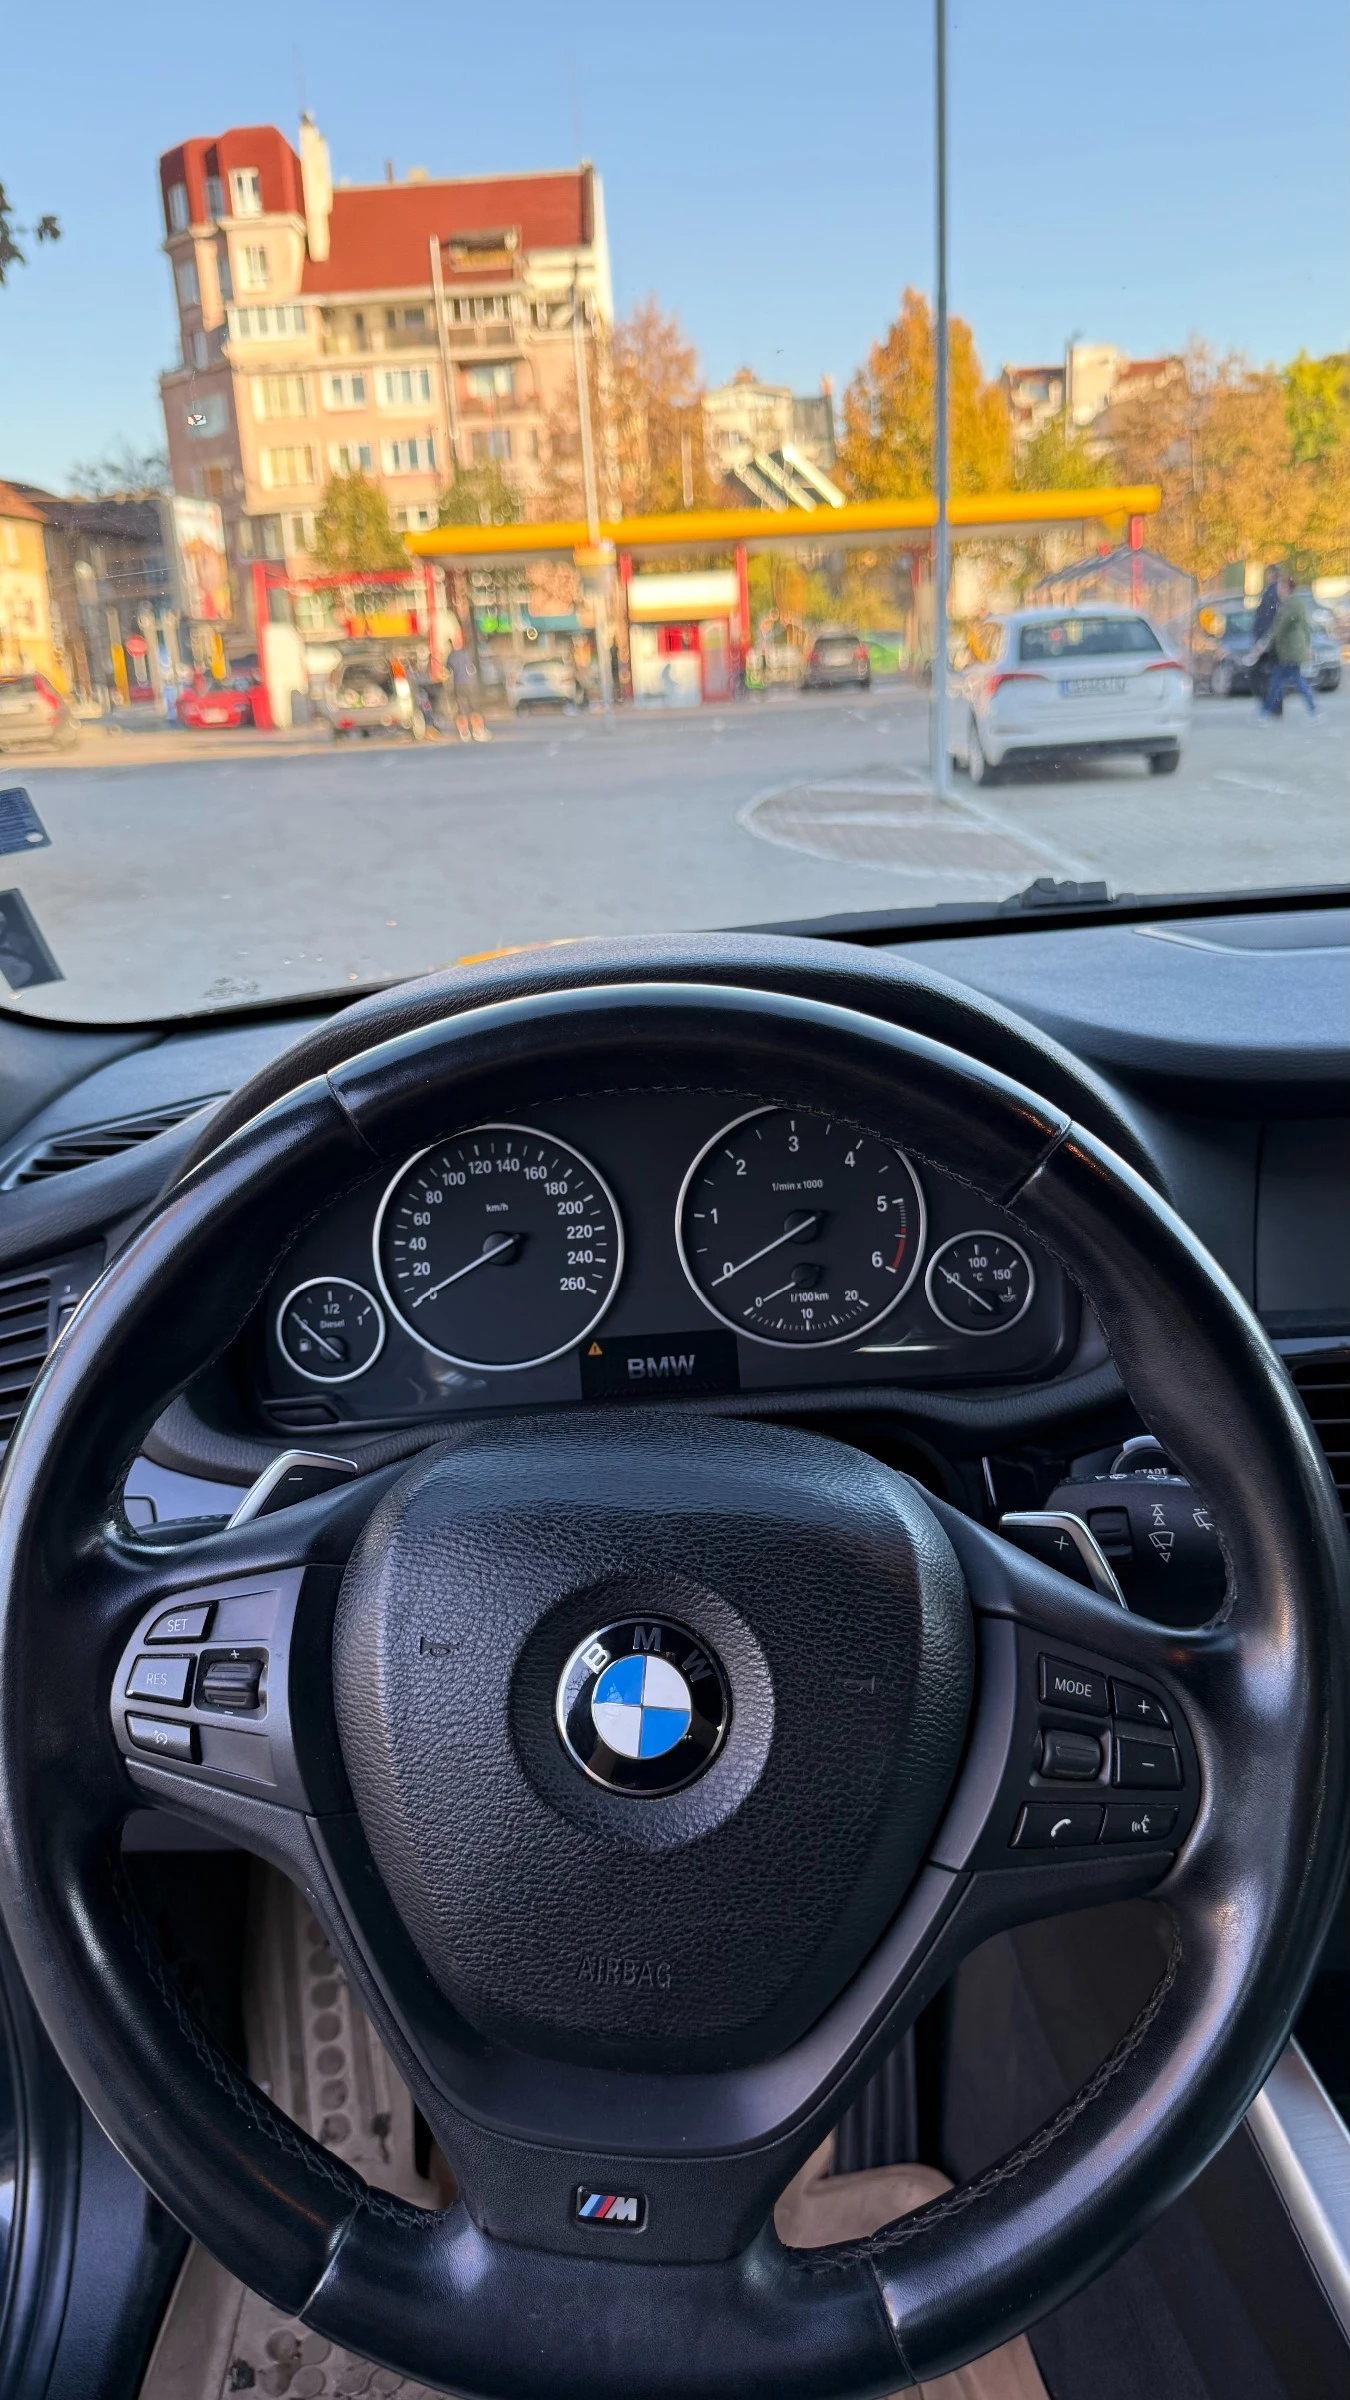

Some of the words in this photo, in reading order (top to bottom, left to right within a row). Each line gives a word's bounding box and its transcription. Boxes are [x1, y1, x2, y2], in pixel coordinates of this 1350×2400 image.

[789, 1136, 799, 1152] 3
[497, 1159, 519, 1172] 140
[845, 1152, 855, 1167] 4
[468, 1161, 492, 1174] 120
[524, 1166, 547, 1180] 160
[736, 1159, 746, 1175] 2
[442, 1172, 465, 1186] 100
[803, 1179, 823, 1188] 1000
[544, 1181, 567, 1195] 180
[426, 1191, 442, 1204] 80
[877, 1196, 887, 1212] 5
[486, 1203, 508, 1212] km/h
[557, 1201, 584, 1216] 200
[414, 1212, 430, 1225] 60
[711, 1208, 717, 1224] 1
[567, 1225, 592, 1239] 220
[409, 1237, 426, 1250] 40
[567, 1250, 593, 1265] 240
[872, 1251, 882, 1267] 6
[968, 1257, 988, 1268] 100
[413, 1262, 430, 1276] 20
[722, 1261, 734, 1279] 0
[992, 1269, 1013, 1280] 150
[559, 1276, 586, 1291] 260
[756, 1297, 762, 1307] 0
[845, 1290, 858, 1301] 20
[324, 1304, 339, 1314] 1/2
[801, 1308, 813, 1319] 10
[320, 1319, 345, 1329] Diesel
[627, 1354, 695, 1379] BMW
[168, 1619, 188, 1632] SET
[147, 1673, 167, 1685] RES
[1055, 1678, 1091, 1697] MODE
[577, 1955, 671, 1988] AIRBAG
